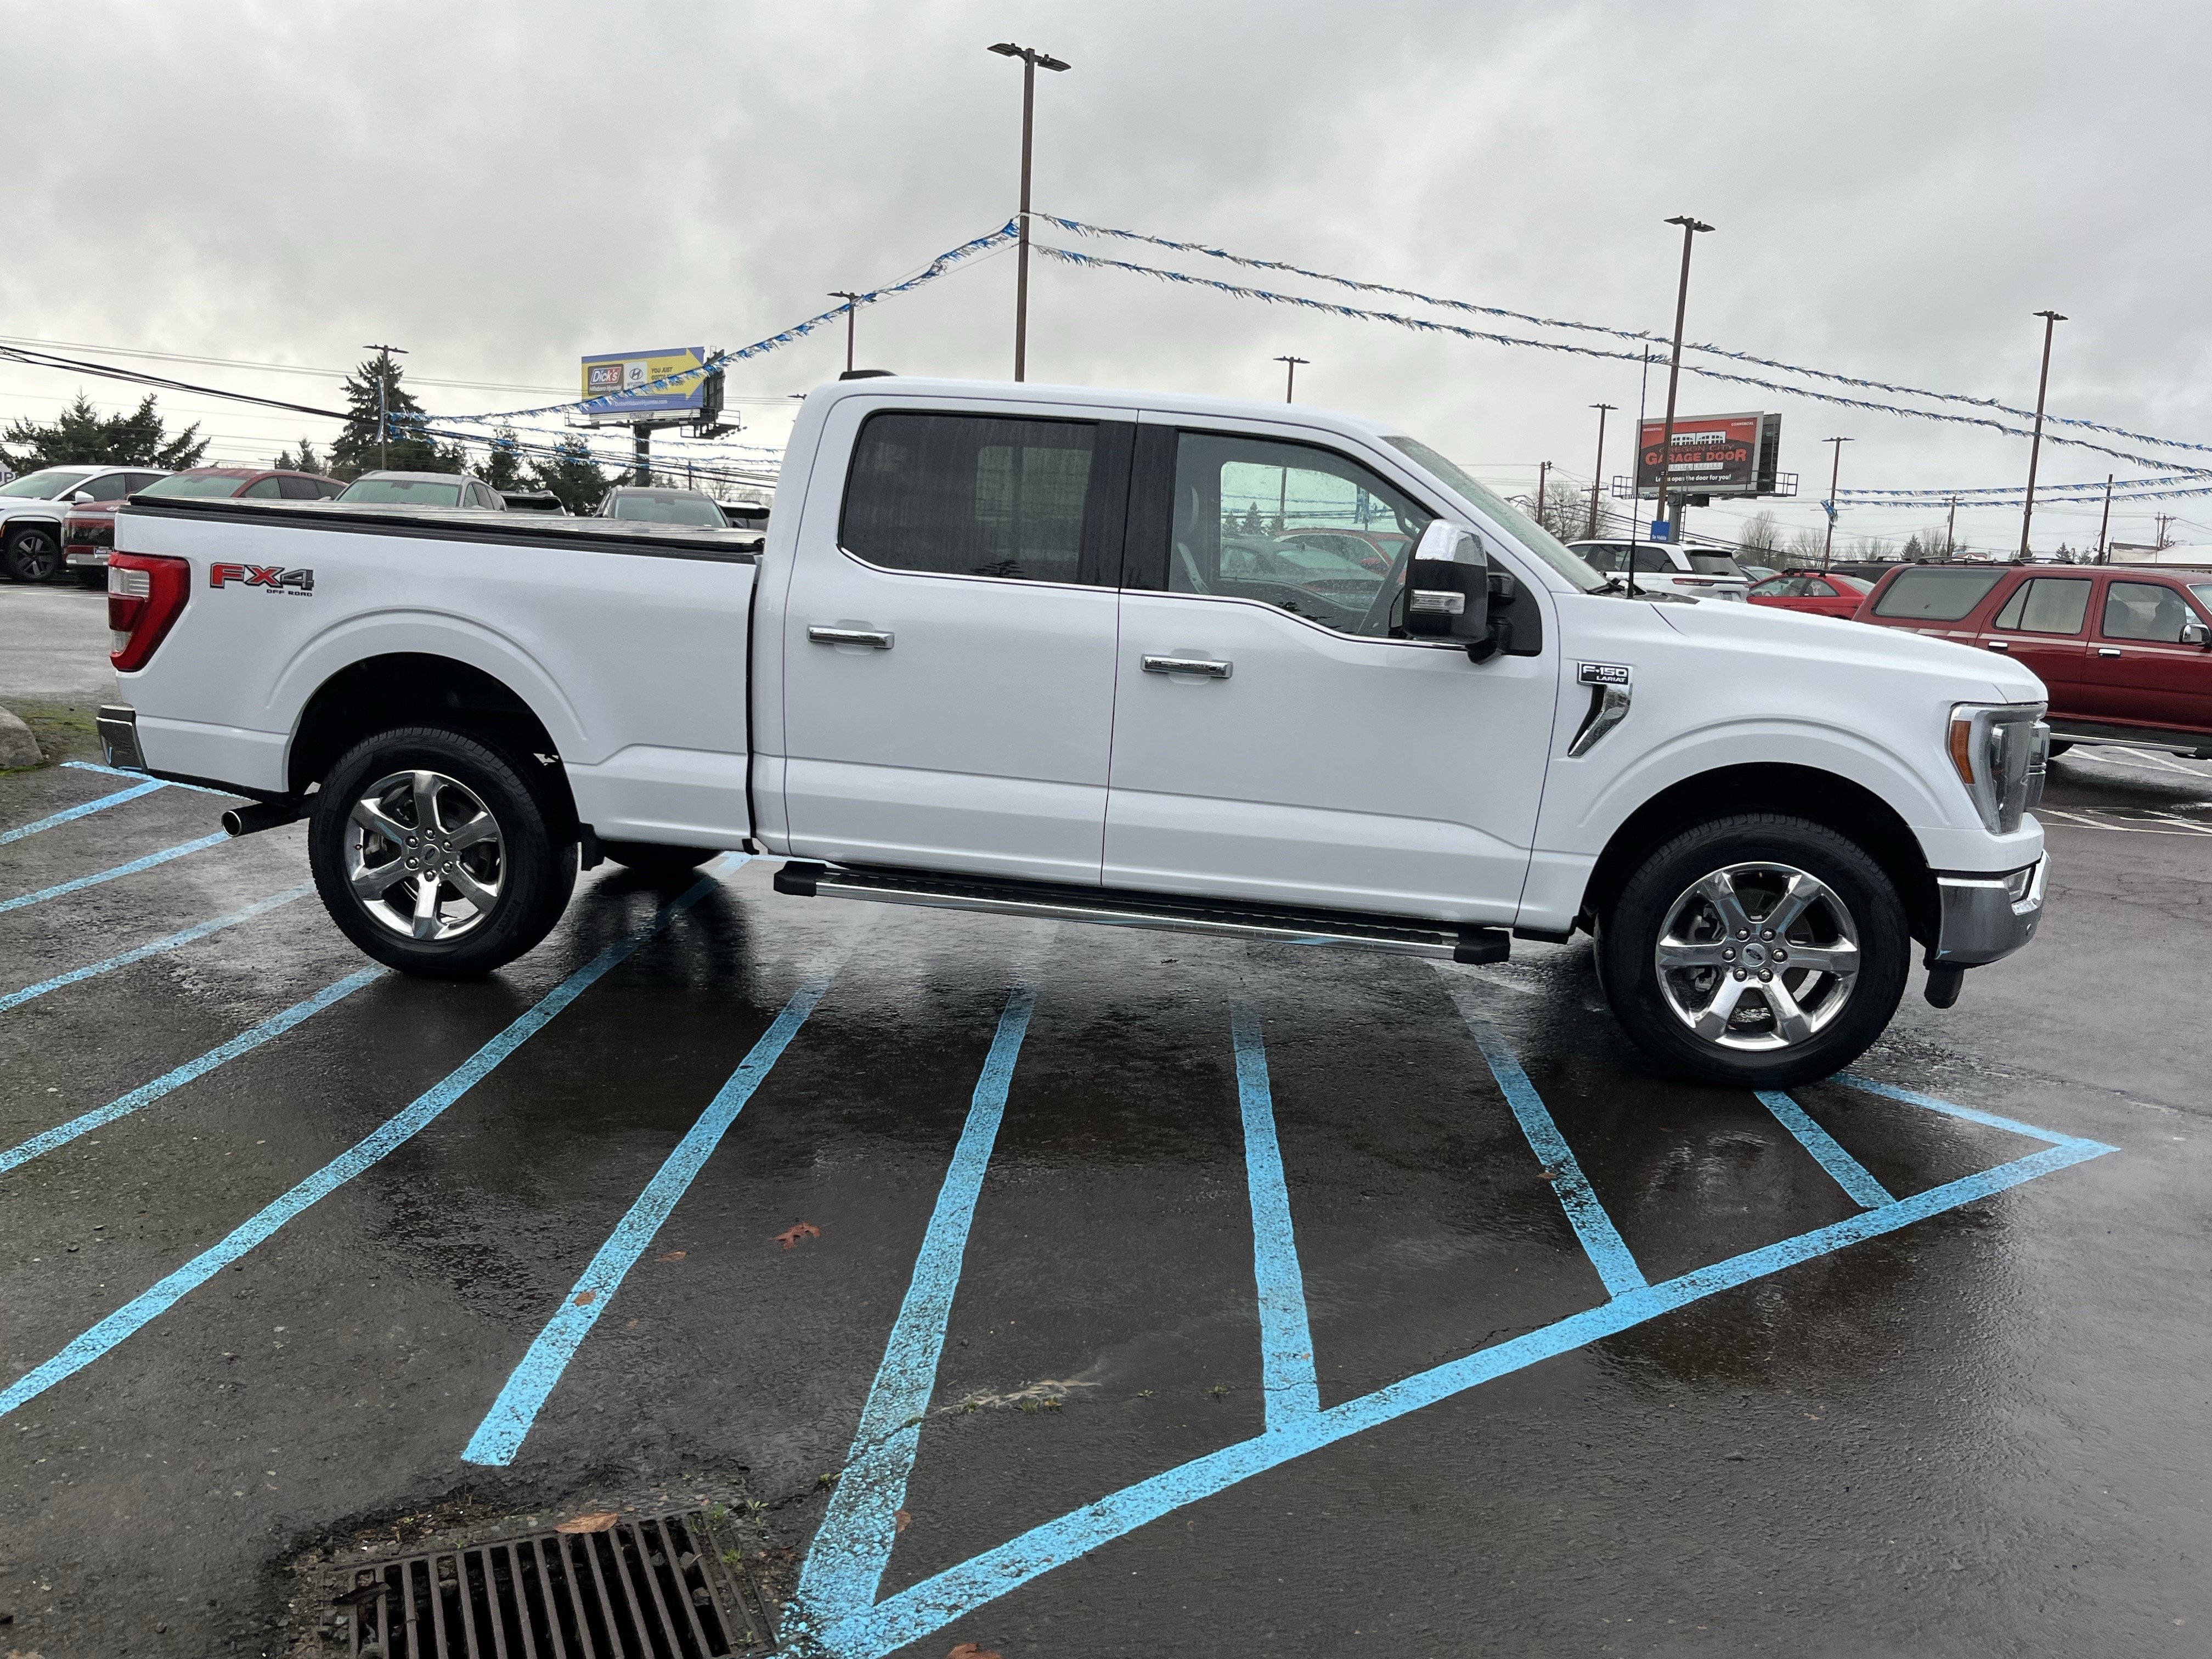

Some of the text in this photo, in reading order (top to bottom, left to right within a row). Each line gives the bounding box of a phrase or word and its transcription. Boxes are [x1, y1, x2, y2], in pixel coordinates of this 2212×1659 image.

[592, 369, 618, 382] Dick's
[1706, 449, 1747, 462] DOOR
[1718, 473, 1731, 482] you!
[210, 562, 314, 591] FX4
[1582, 665, 1628, 678] F-150
